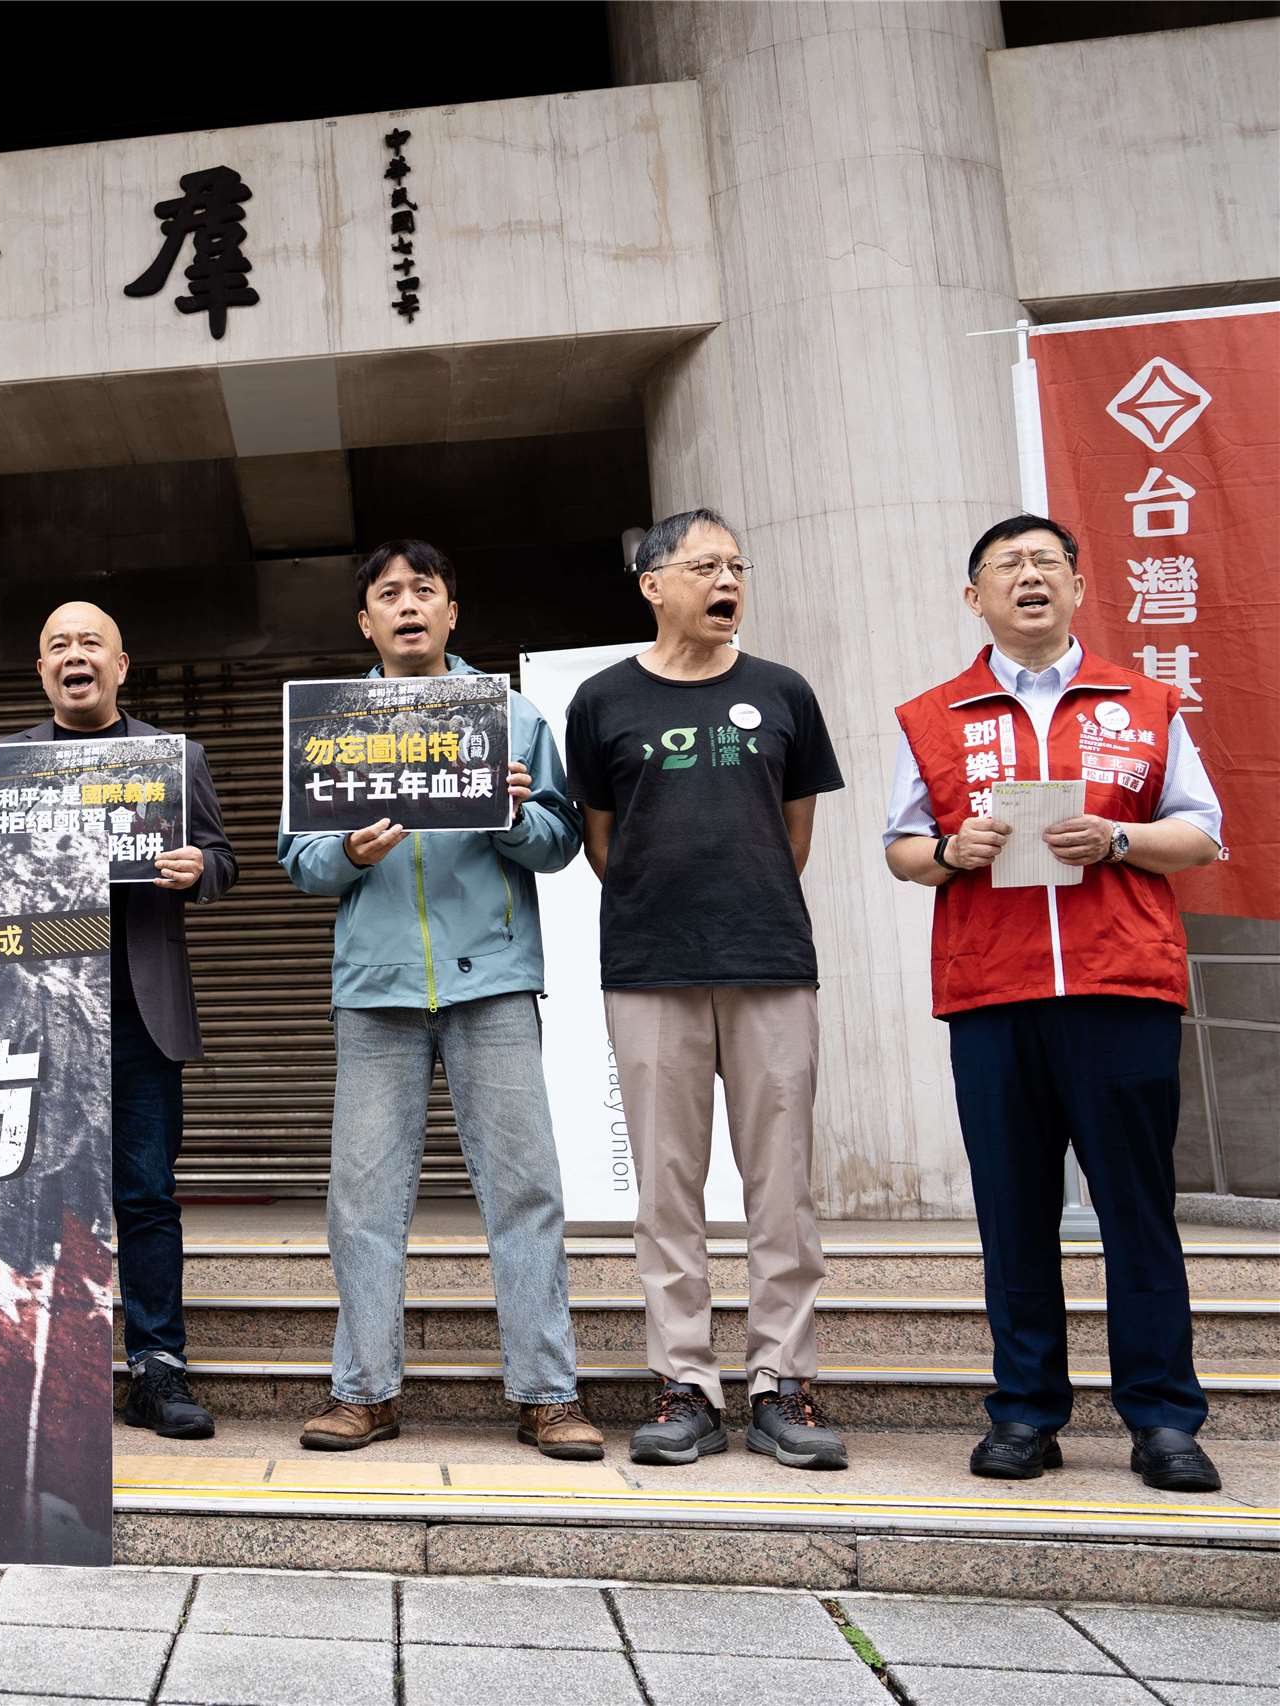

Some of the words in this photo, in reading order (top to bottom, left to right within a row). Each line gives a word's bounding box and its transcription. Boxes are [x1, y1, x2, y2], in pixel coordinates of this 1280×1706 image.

[1124, 467, 1203, 752] 台灣基
[717, 726, 740, 766] 綠黨
[305, 768, 494, 802] 七十五年血淚
[610, 1121, 631, 1192] Union
